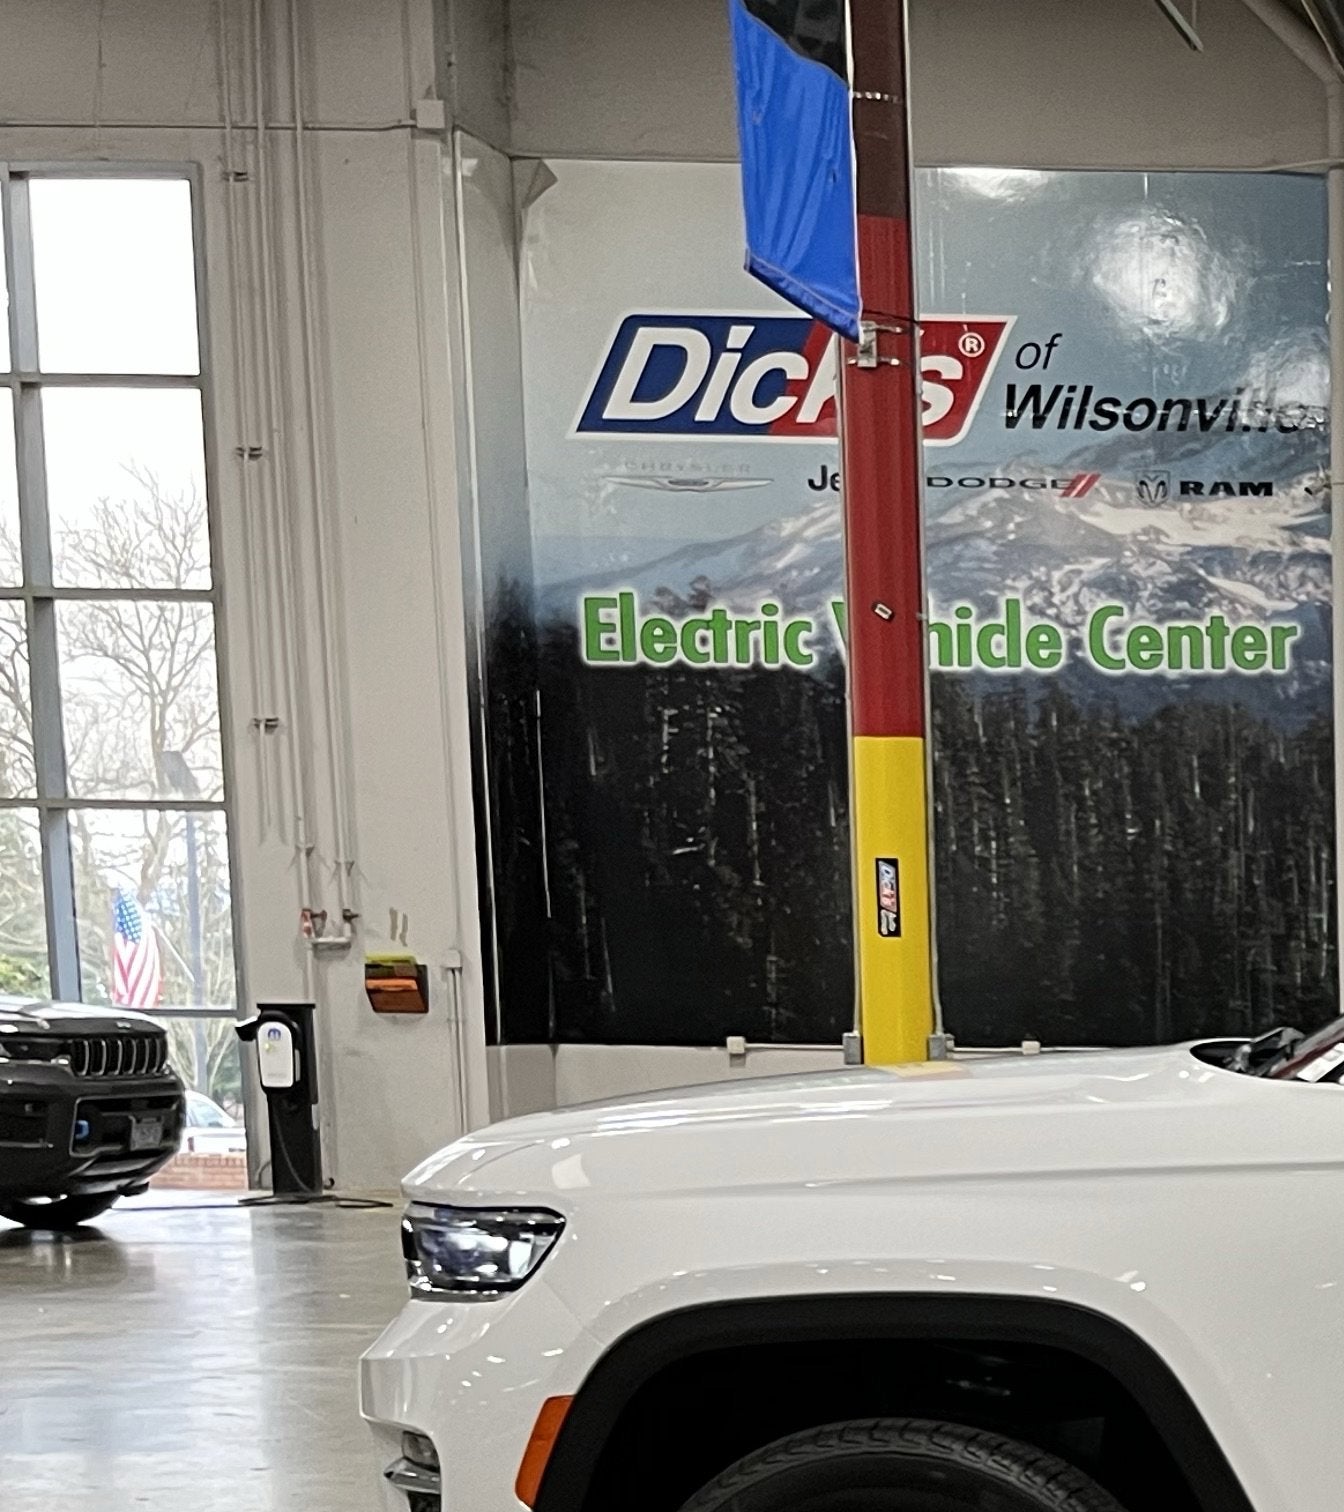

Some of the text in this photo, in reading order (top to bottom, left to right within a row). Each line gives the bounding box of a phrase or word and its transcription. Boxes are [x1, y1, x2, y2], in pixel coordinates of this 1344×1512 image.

[1015, 333, 1063, 370] of
[807, 464, 841, 492] Je
[926, 475, 1072, 491] DODGE
[1179, 481, 1273, 497] RAM
[584, 592, 1298, 670] Electric hicle Center
